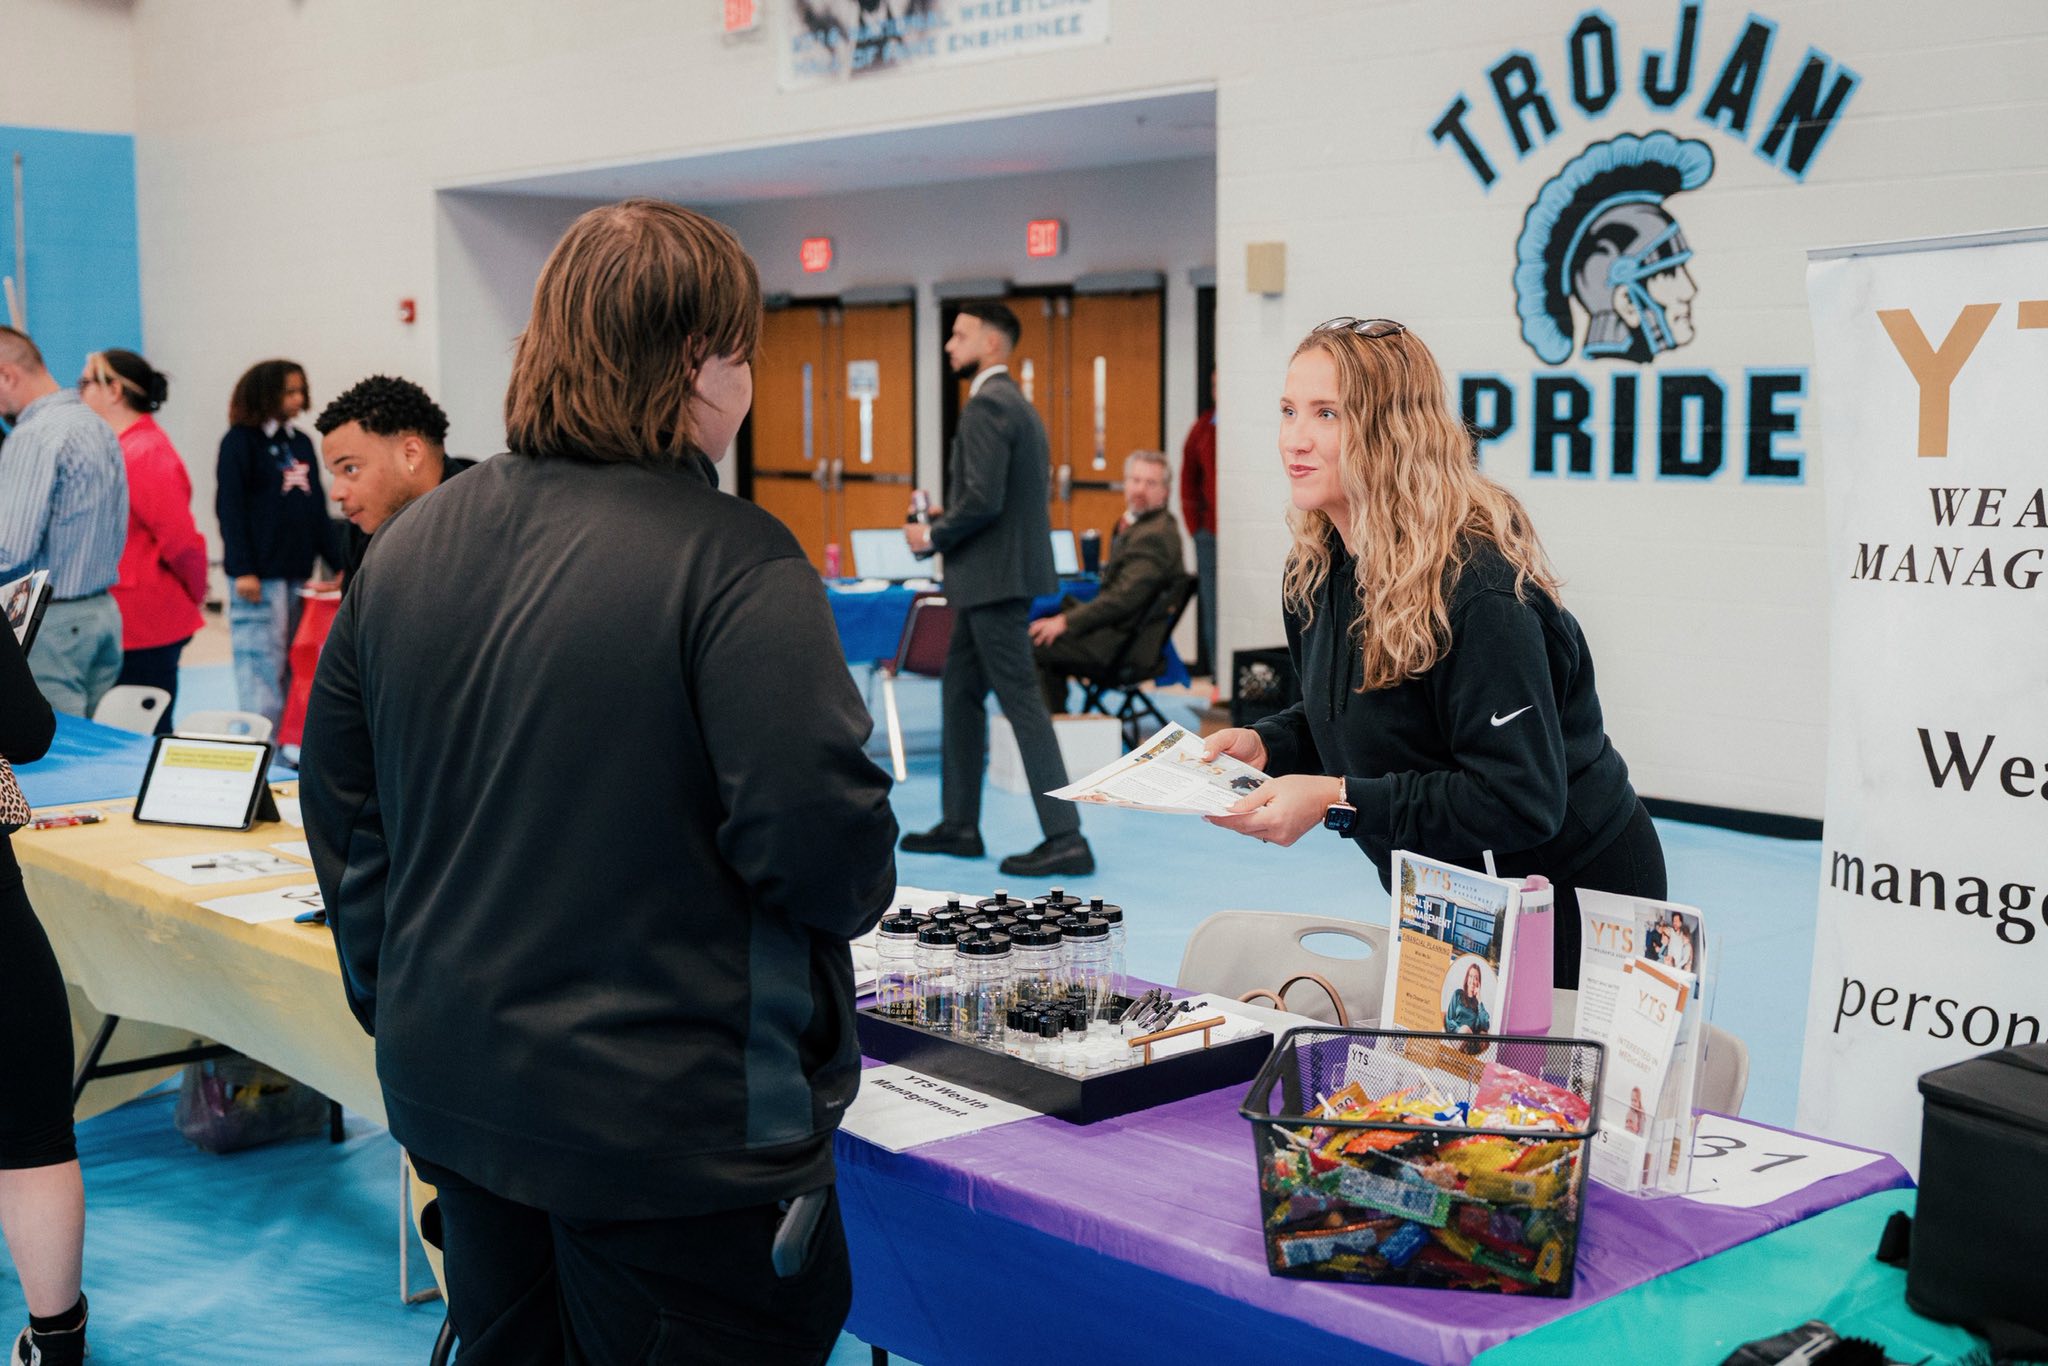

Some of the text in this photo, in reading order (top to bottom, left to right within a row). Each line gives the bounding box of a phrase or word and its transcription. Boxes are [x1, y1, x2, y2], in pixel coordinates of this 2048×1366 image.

[1427, 0, 1862, 194] TROJAN
[1458, 366, 1809, 486] PRIDE
[1917, 728, 2048, 800] We
[1418, 865, 1452, 892] YTS
[1830, 850, 2048, 945] manag
[1403, 906, 1452, 929] MANAGEMENT
[1591, 919, 1633, 953] YTS
[1639, 989, 1667, 1022] YTS
[1833, 976, 2048, 1049] person
[1351, 1049, 1370, 1066] YTS
[870, 1079, 968, 1117] Management
[904, 1075, 989, 1110] YTS Wealth
[1597, 1129, 1608, 1144] TS
